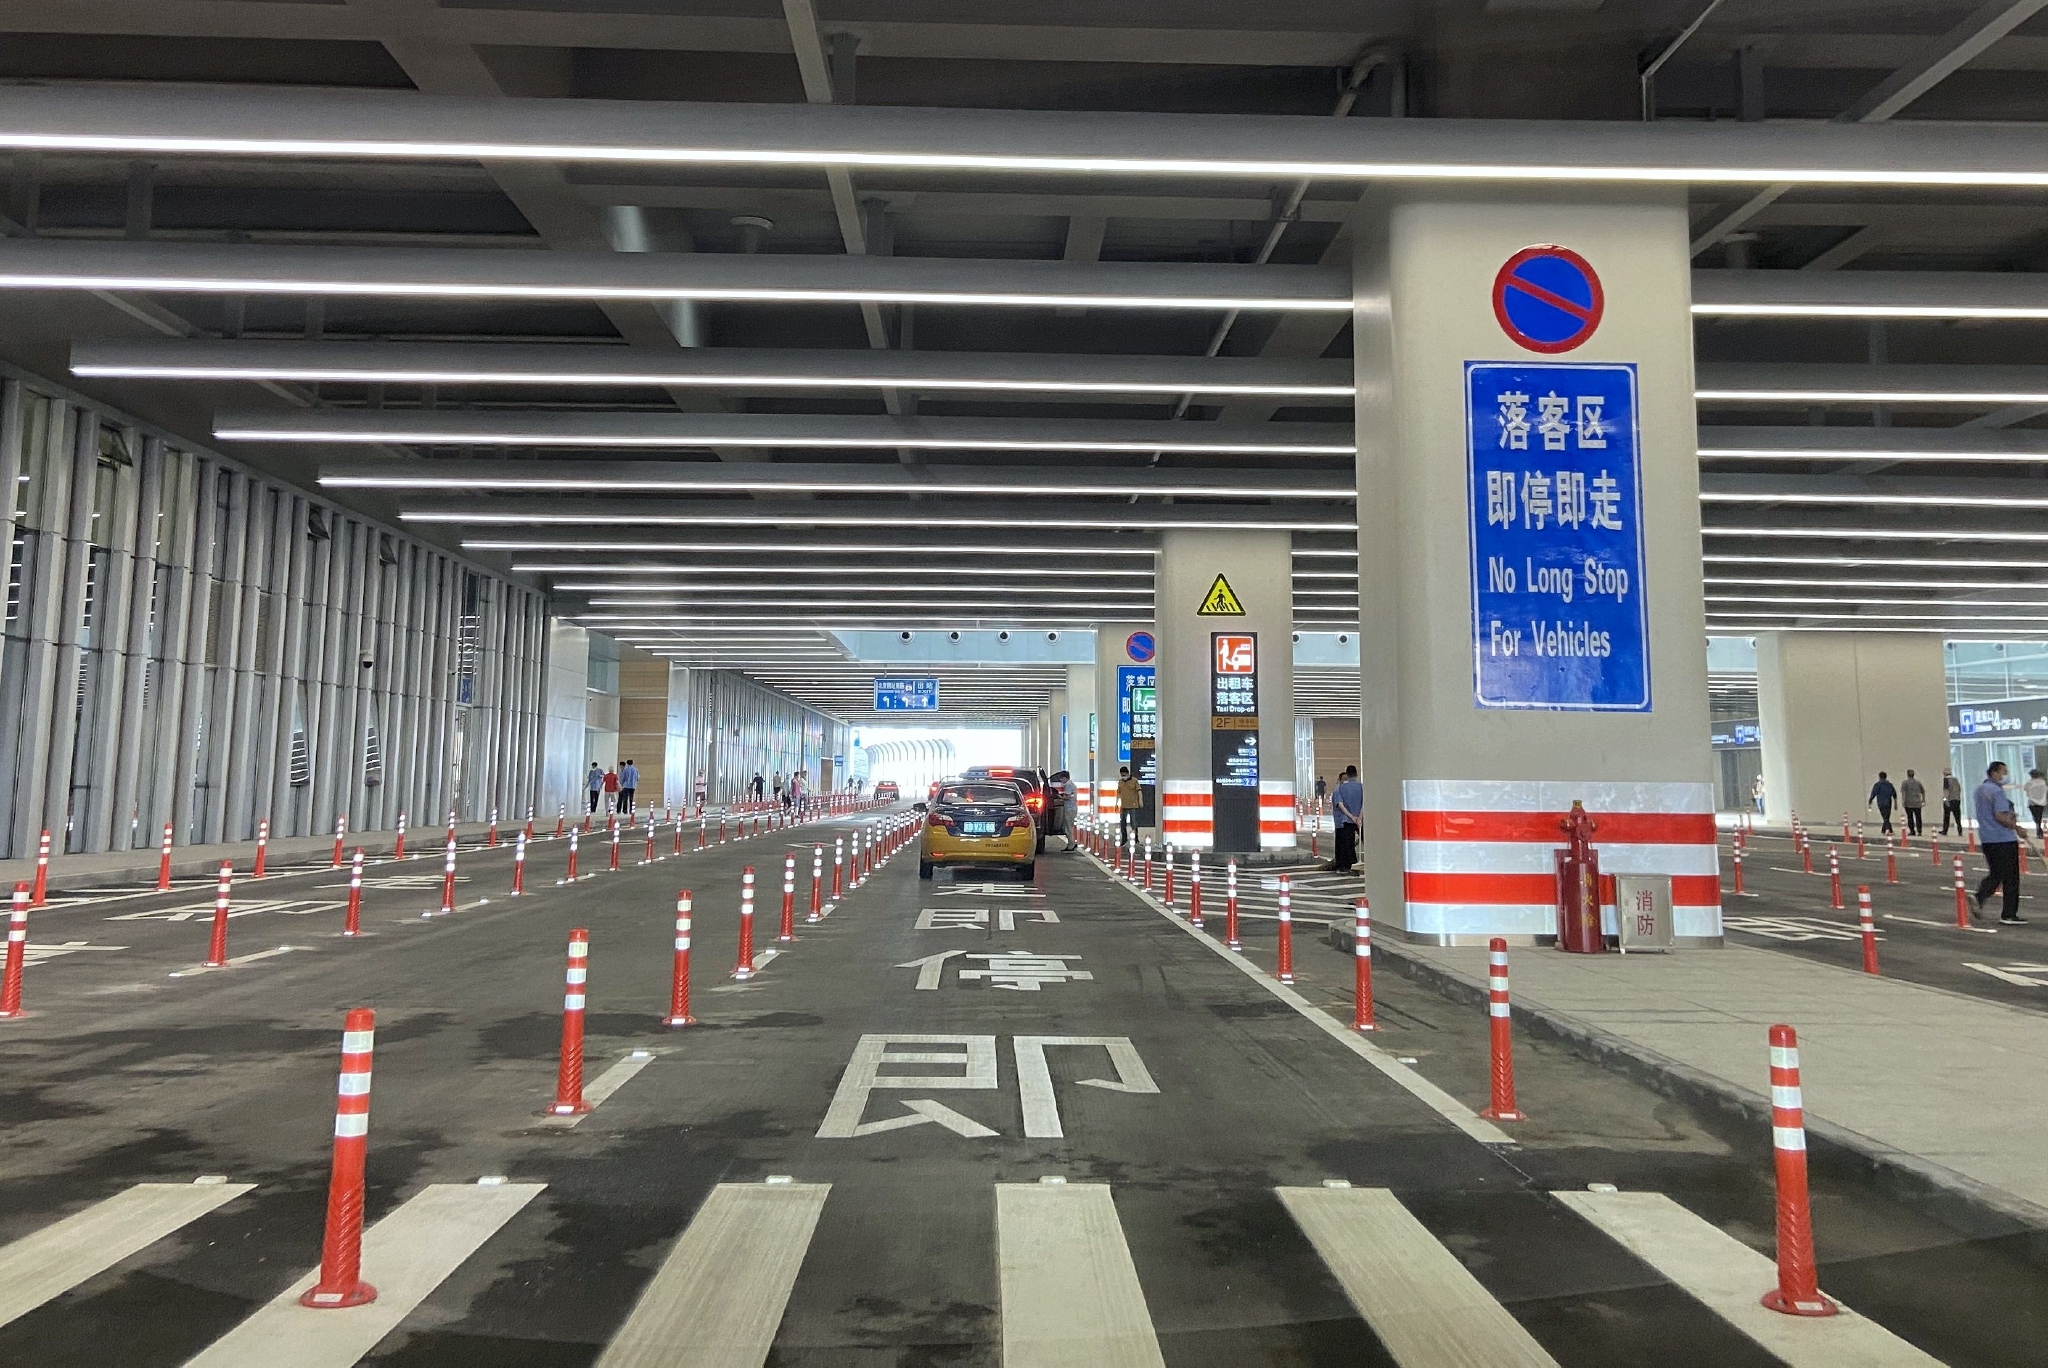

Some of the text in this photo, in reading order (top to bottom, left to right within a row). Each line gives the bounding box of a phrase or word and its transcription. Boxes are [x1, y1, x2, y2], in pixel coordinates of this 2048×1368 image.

[1497, 390, 1607, 451] 落客区
[1486, 469, 1623, 531] 即停即走
[1489, 557, 1629, 604] No Long Stop
[1491, 620, 1611, 658] For Vehicles
[1216, 677, 1254, 691] 出租车
[1216, 692, 1254, 705] 落客区
[1216, 718, 1231, 727] 2F
[914, 908, 1060, 931] 即
[1635, 889, 1655, 937] 消防
[893, 950, 1094, 991] 停
[815, 1033, 1161, 1139] 即
